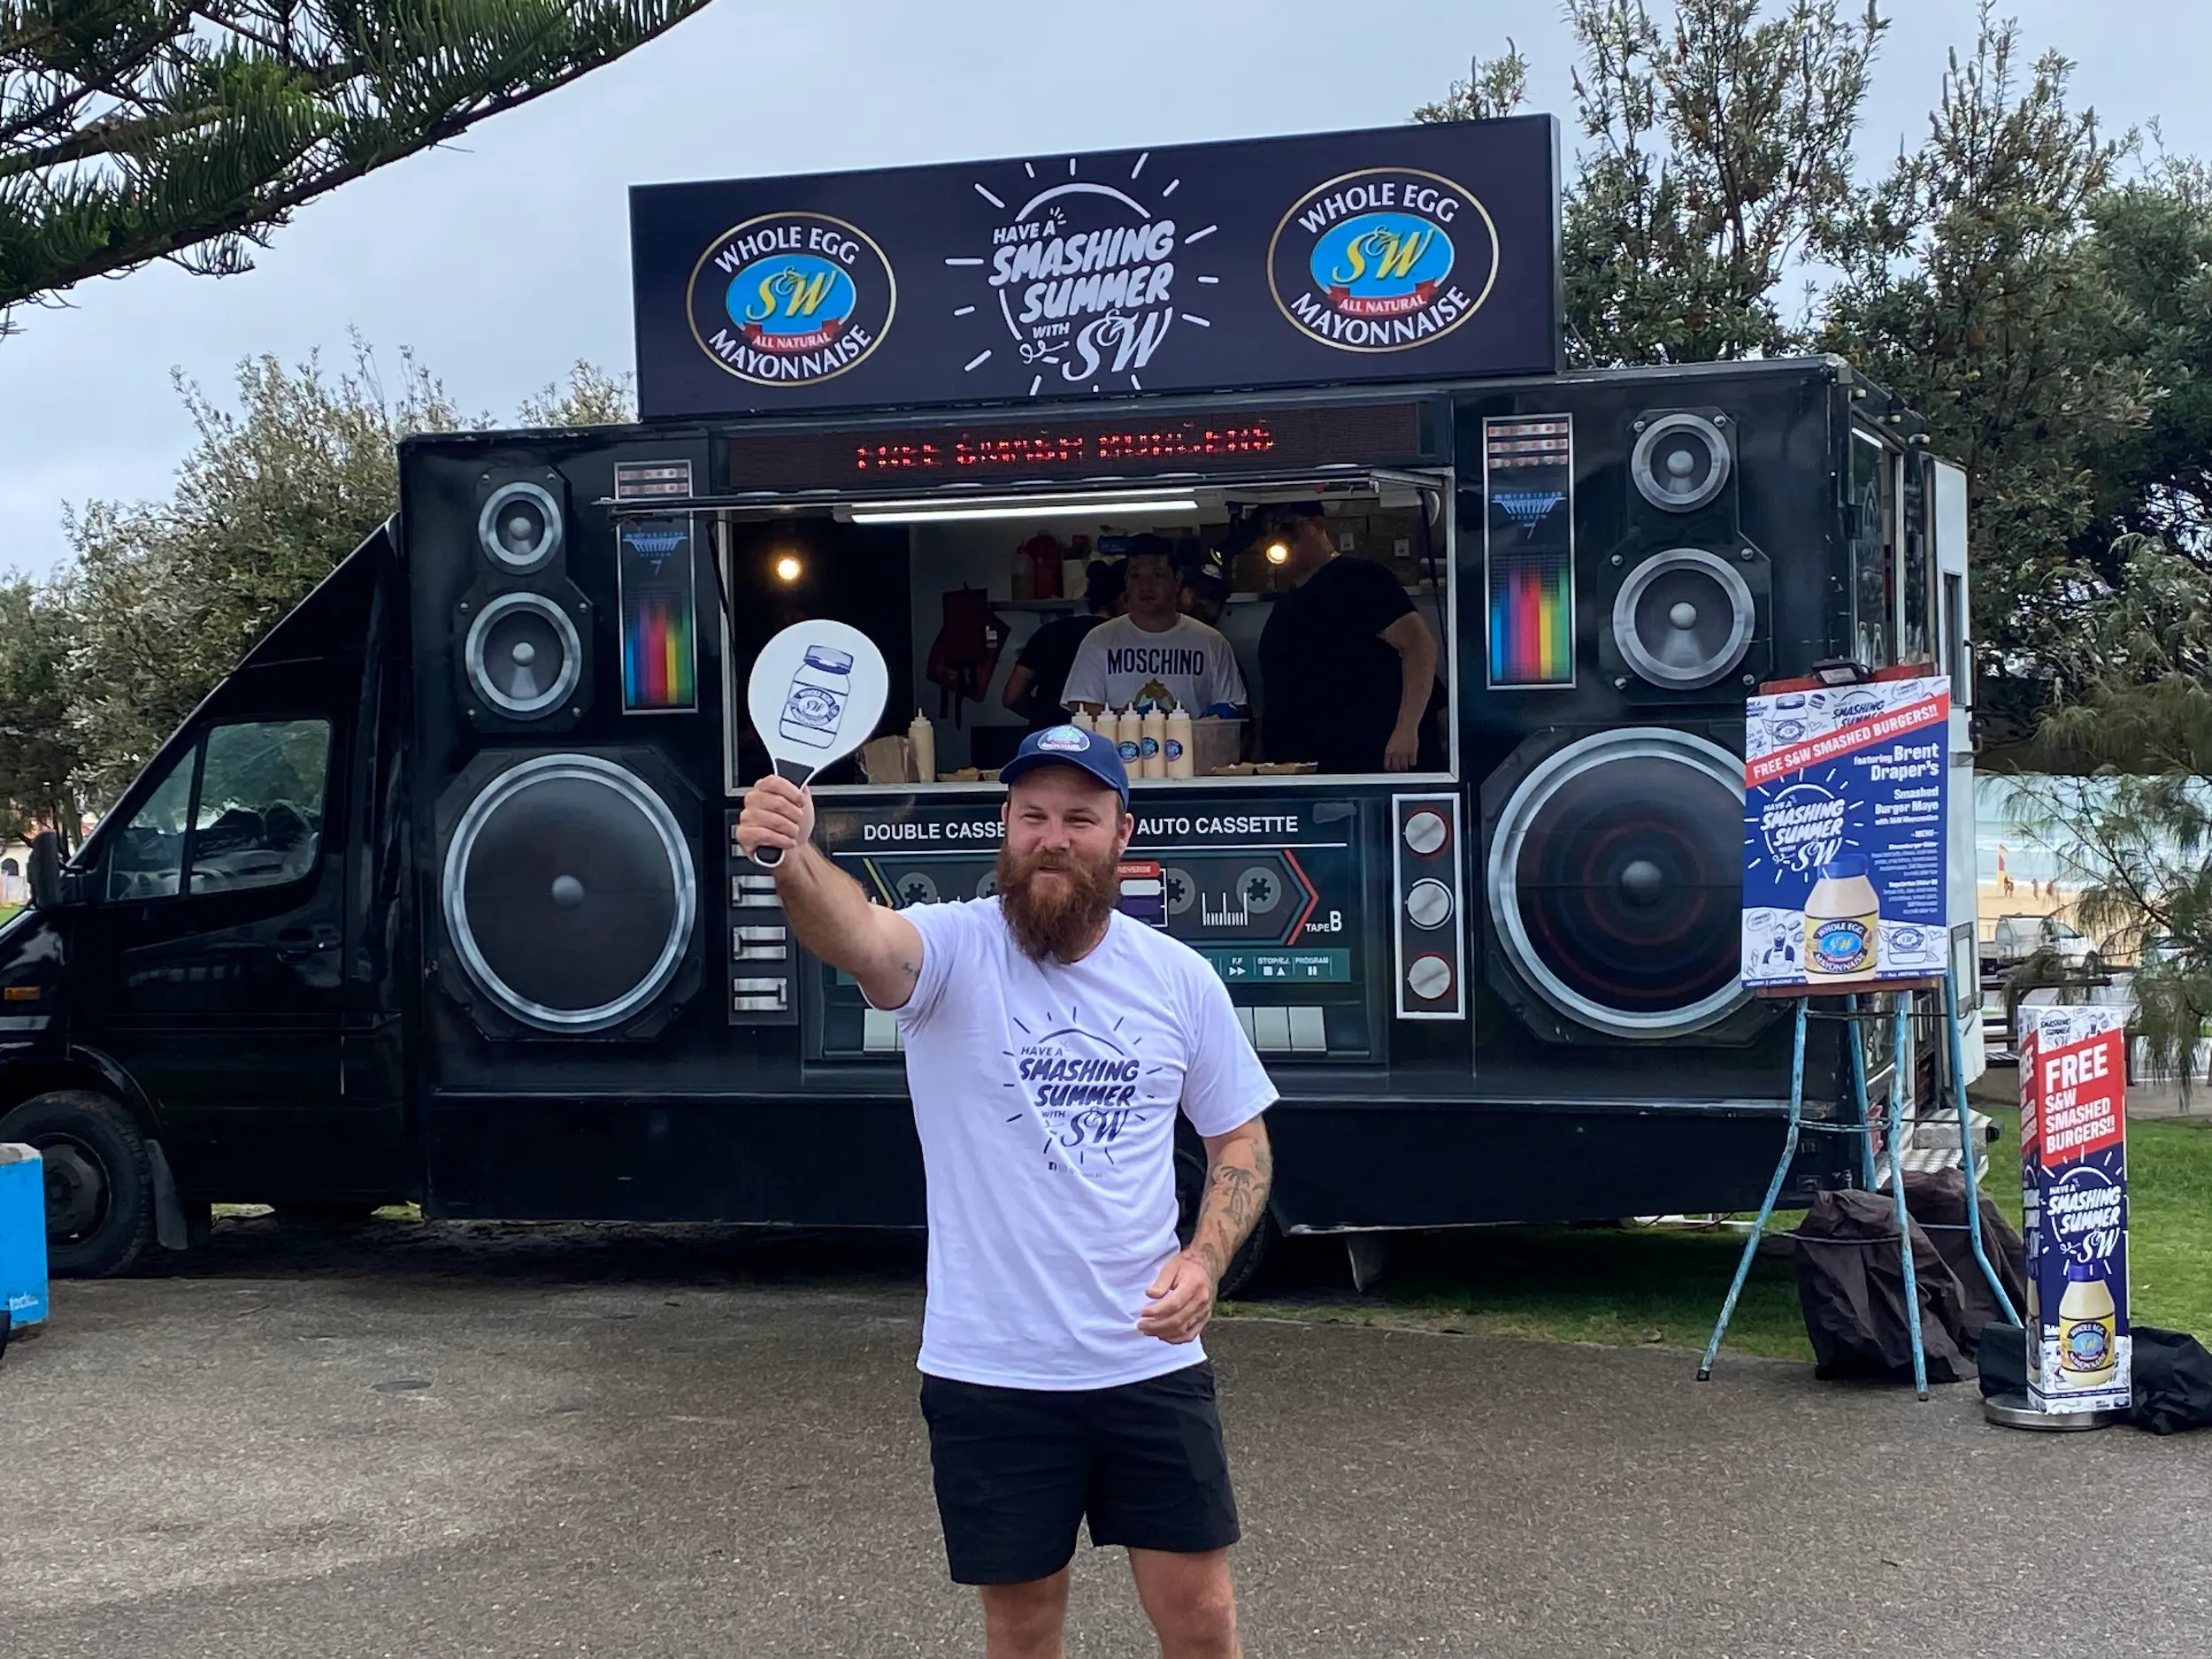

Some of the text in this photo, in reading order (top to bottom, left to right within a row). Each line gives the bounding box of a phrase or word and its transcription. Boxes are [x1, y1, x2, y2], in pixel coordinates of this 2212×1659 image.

[1298, 183, 1460, 234] WHOLE EGG
[993, 219, 1056, 243] HAVE A
[714, 227, 860, 274] WHOLE EGG
[988, 219, 1175, 286] SMASHING
[1019, 262, 1173, 323] SUMMER
[1339, 294, 1427, 313] ALL NATURAL
[1290, 285, 1471, 346] MAYONNAISE
[752, 332, 832, 349] ALL NATURAL
[1033, 322, 1070, 339] WITH
[709, 324, 872, 380] MAYONNAISE
[1108, 648, 1204, 676] MOSCHINO
[1832, 699, 1885, 719] SMASHING
[1753, 757, 1785, 780] FREE
[1785, 747, 1812, 769] S&W
[1813, 726, 1871, 760] SMASHED
[1873, 703, 1939, 737] BURGERS!!
[1854, 742, 1939, 766] featuring Brent
[1870, 760, 1939, 782] Draper's
[1763, 801, 1786, 813] HAVE
[1893, 786, 1939, 801] Smashed
[1760, 798, 1846, 831] SMASHING
[1875, 800, 1939, 815] Burger Mayo
[864, 815, 1299, 841] DOUBLE CASSE AUTO CASSETTE
[1773, 817, 1844, 847] SUMMER
[1305, 910, 1342, 933] TAPE B
[1816, 922, 1847, 937] WHOLE
[1020, 1046, 1064, 1056] HAVE A
[1018, 1057, 1140, 1082] SMASHING
[2045, 1042, 2108, 1094] FREE
[1033, 1085, 1136, 1107] SUMMER
[2045, 1087, 2078, 1115] S&W
[2045, 1097, 2111, 1134] SMASHED
[2046, 1114, 2116, 1155] BURGERS!!
[2047, 1185, 2122, 1216] SMASHING
[2060, 1205, 2121, 1235] SUMMER
